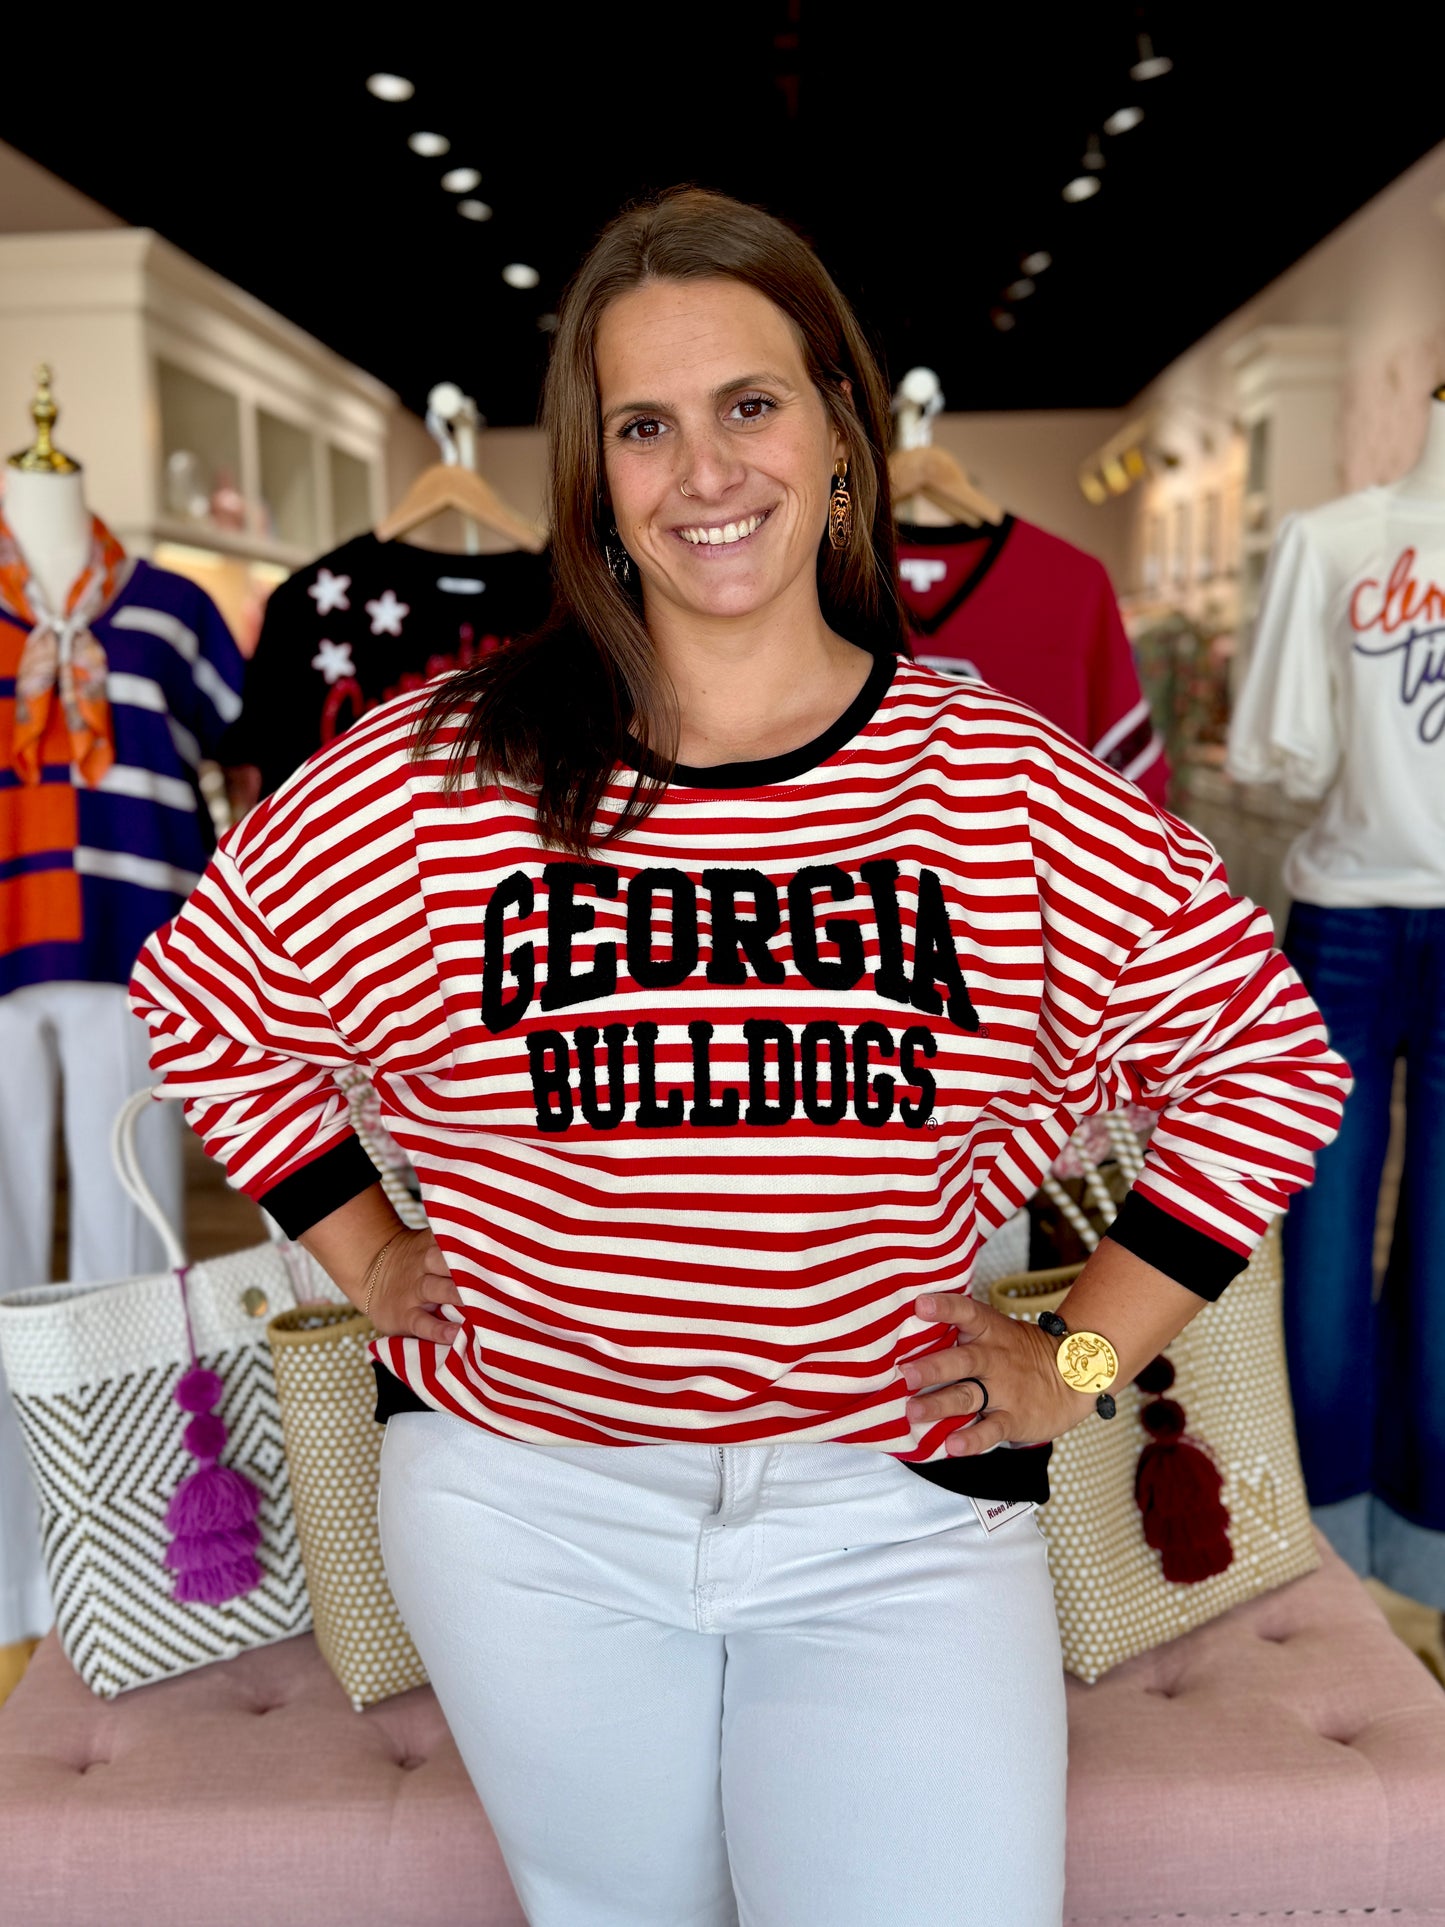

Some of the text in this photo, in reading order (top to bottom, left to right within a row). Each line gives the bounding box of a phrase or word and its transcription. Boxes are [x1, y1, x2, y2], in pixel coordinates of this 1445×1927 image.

[481, 859, 980, 1034] GEORGIA
[525, 1019, 938, 1132] BULLDOGS
[986, 1504, 1006, 1519] Risen
